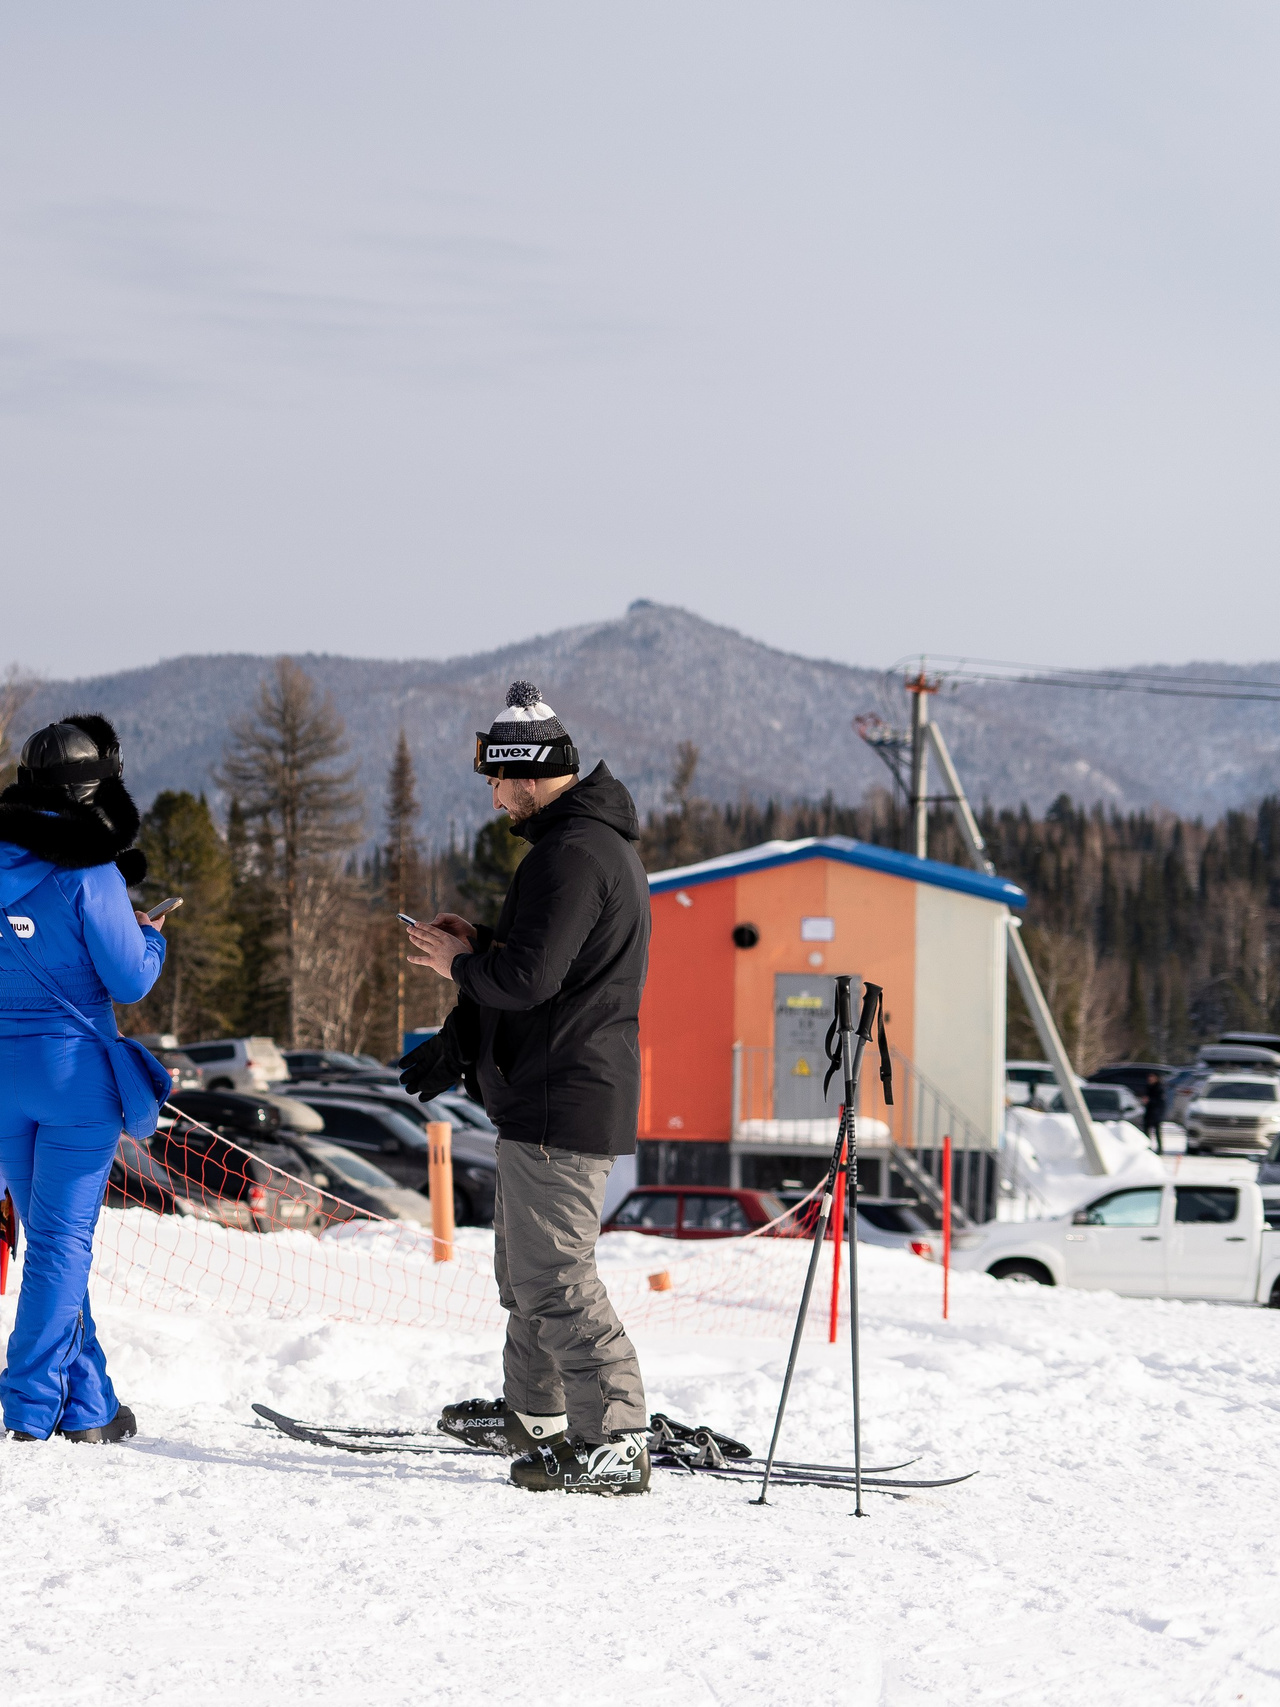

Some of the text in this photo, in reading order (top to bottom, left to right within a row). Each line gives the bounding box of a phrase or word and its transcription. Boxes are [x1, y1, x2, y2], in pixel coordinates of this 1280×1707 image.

[488, 748, 531, 758] uvex
[458, 1417, 505, 1428] ANGE
[564, 1469, 641, 1487] LANGE
